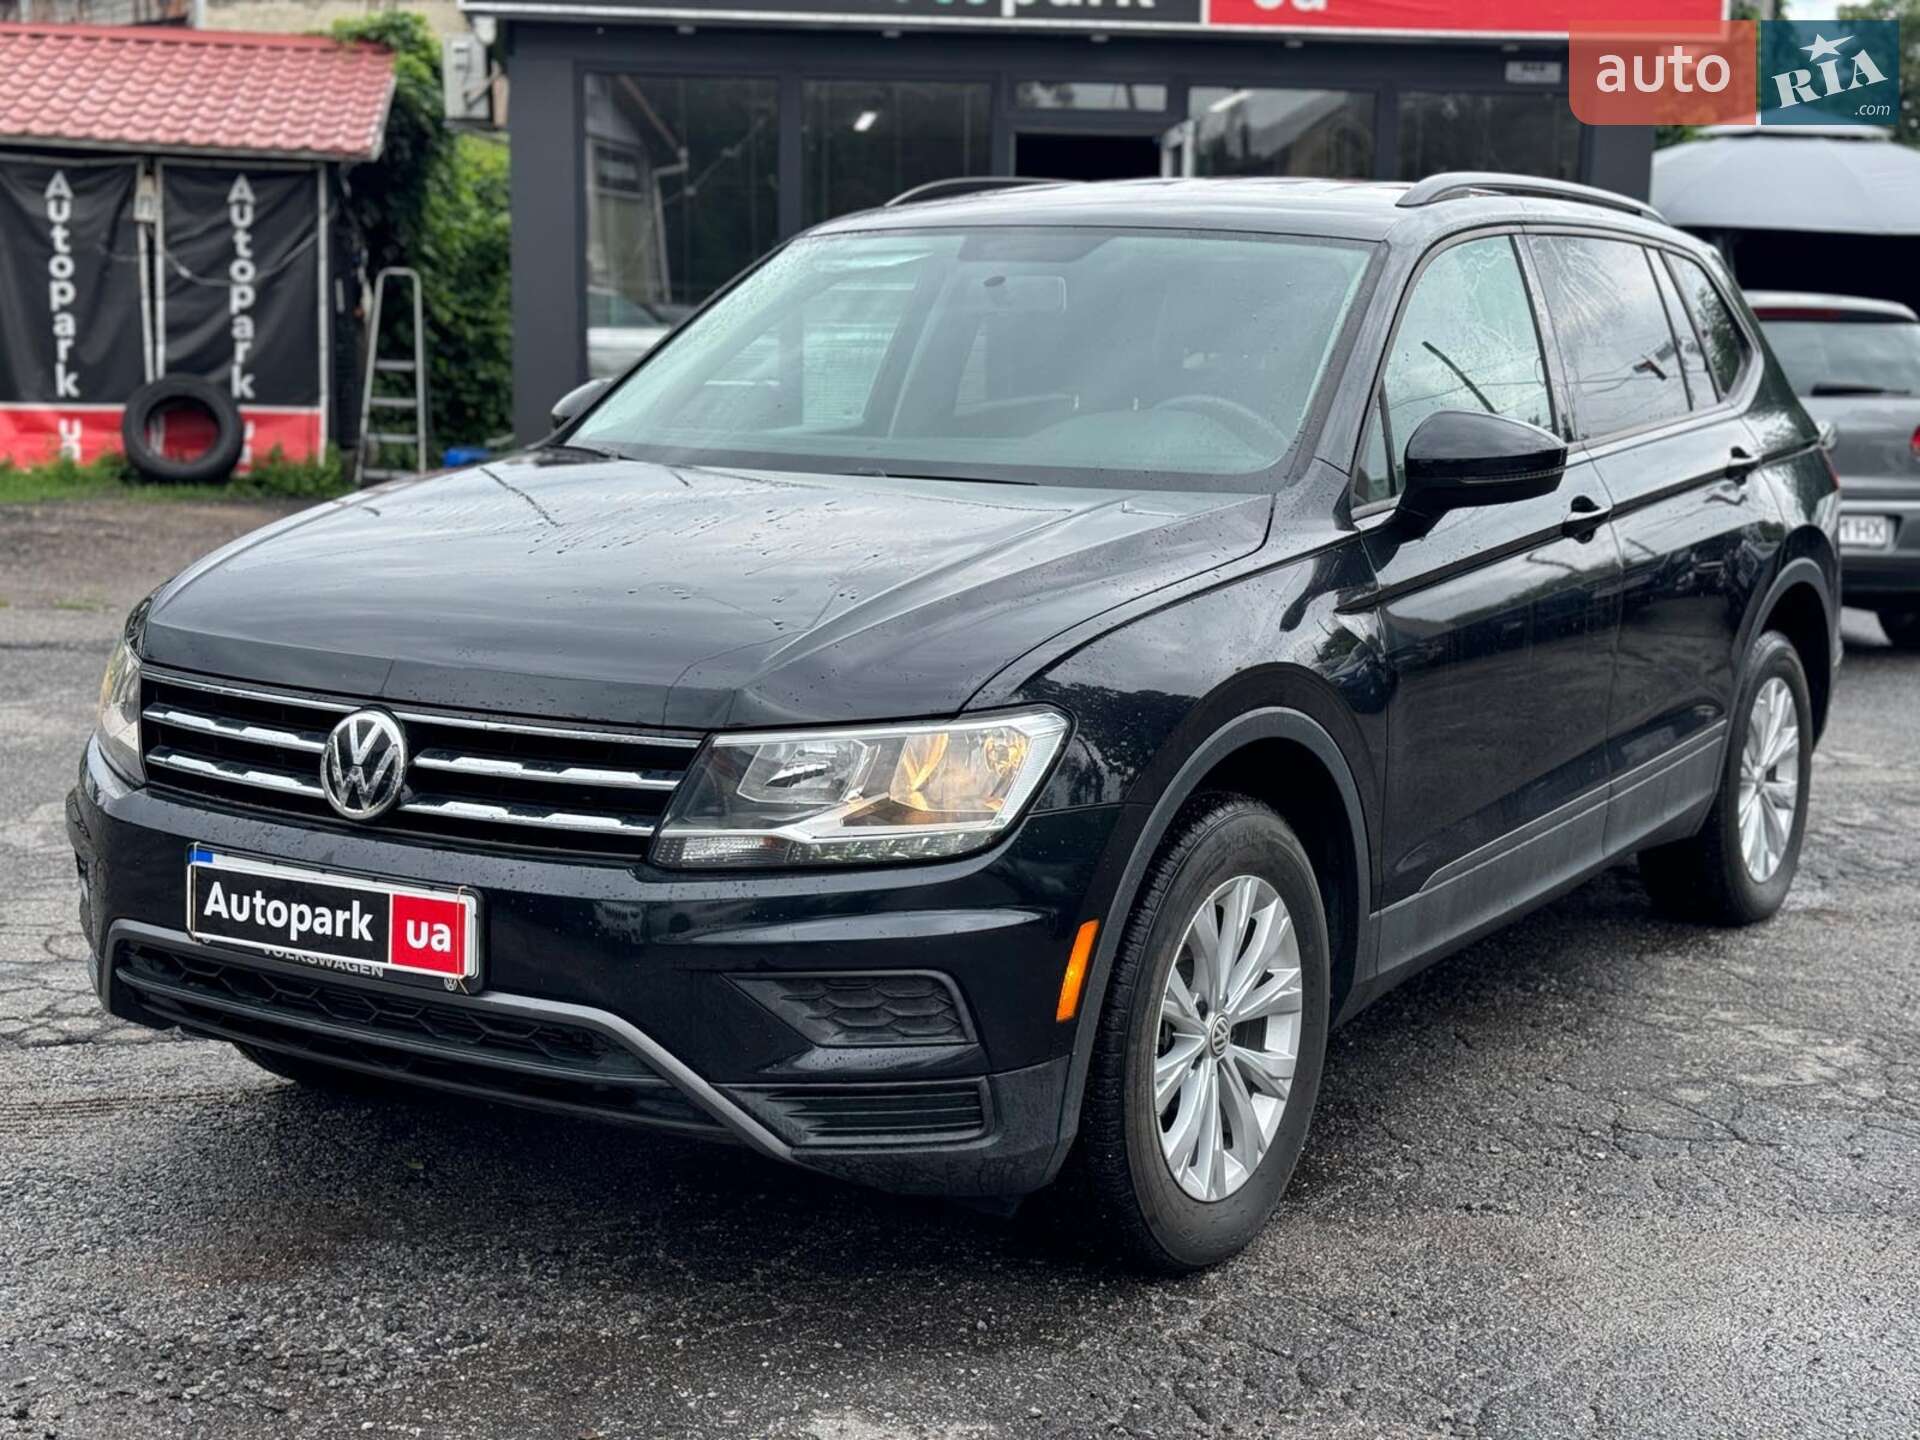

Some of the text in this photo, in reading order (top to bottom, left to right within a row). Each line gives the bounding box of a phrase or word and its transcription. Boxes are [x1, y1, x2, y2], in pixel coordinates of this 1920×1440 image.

[44, 170, 80, 398] Autopark
[227, 173, 256, 399] Autopark
[203, 881, 451, 953] Autopark ua
